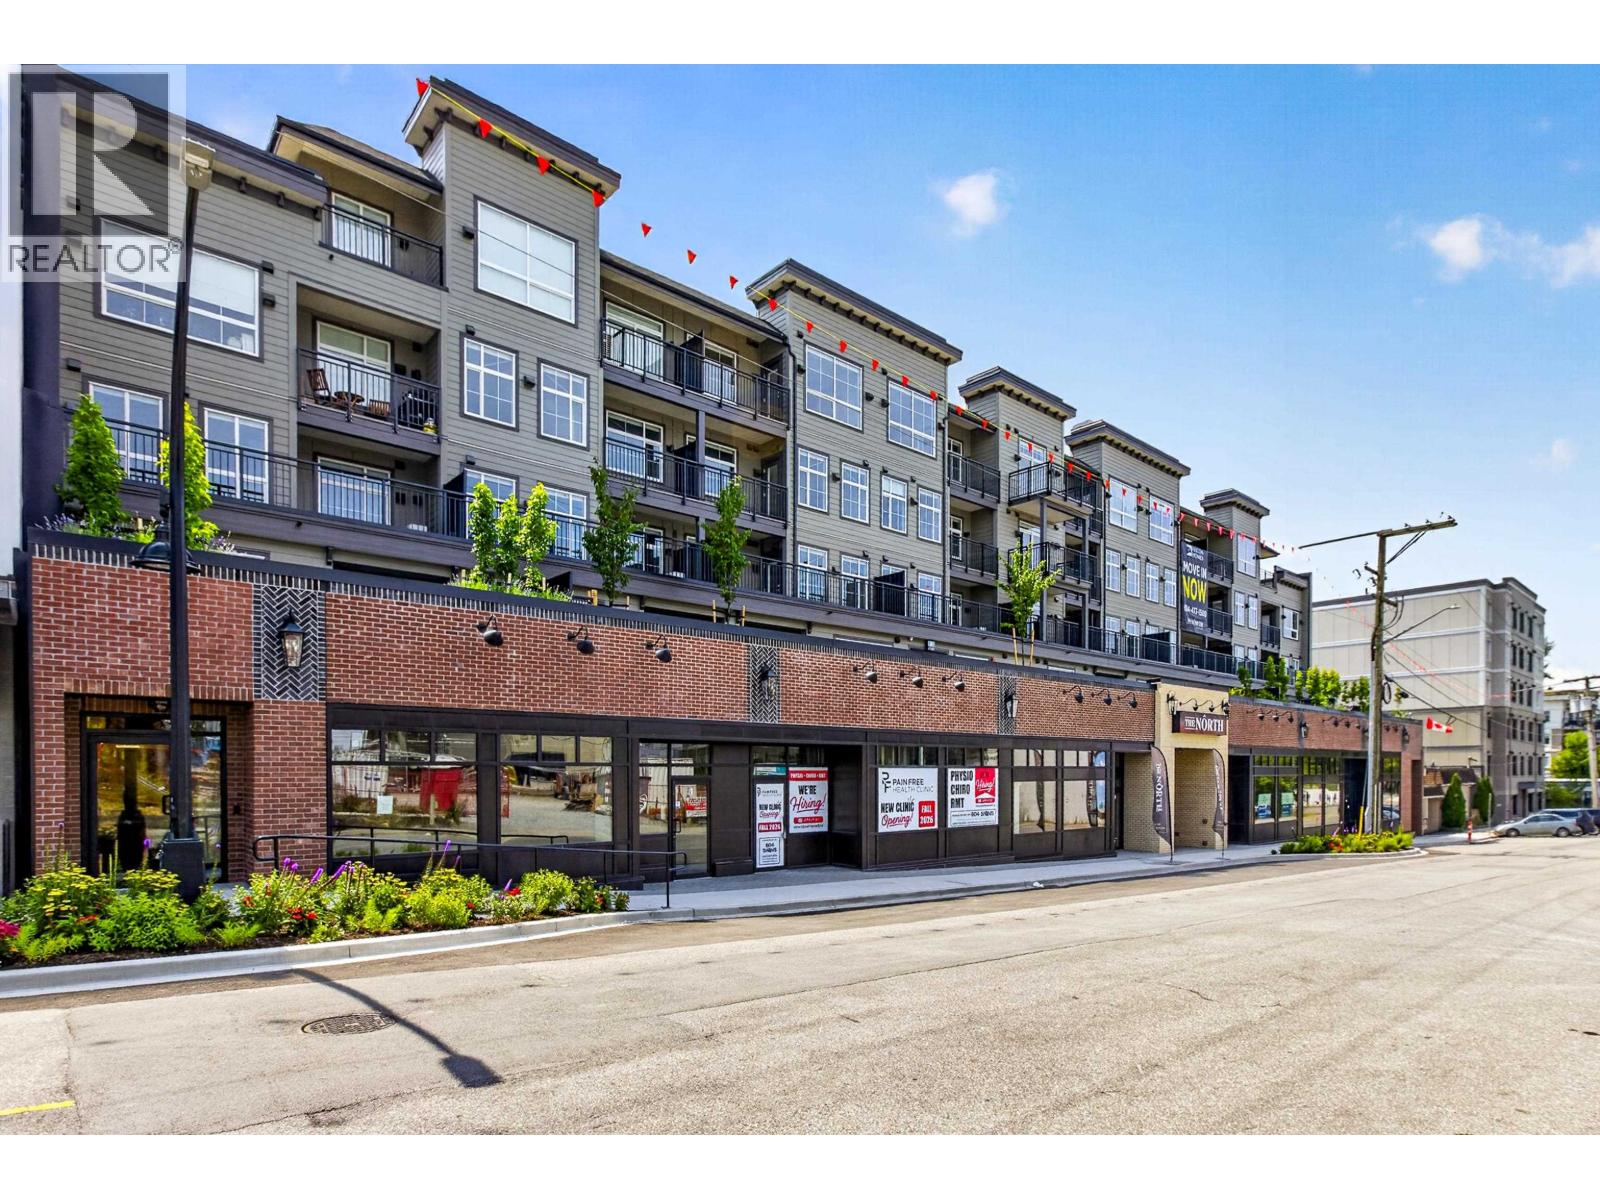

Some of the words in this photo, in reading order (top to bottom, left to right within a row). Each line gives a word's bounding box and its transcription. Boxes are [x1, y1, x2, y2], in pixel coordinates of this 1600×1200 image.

[1183, 561, 1200, 576] MOVE
[1201, 566, 1207, 579] IN
[1183, 575, 1207, 604] NOW
[1184, 718, 1196, 728] THE
[950, 770, 974, 782] PHYSIO
[798, 785, 816, 795] WE'RE
[892, 785, 915, 793] HEALTH
[916, 785, 934, 793] CLINIC
[950, 784, 971, 795] CHIRO
[790, 793, 827, 815] Hiring!
[880, 802, 895, 813] NEW
[895, 801, 915, 813] CLINIC
[921, 804, 933, 813] FALL
[950, 797, 965, 809] RMT
[881, 812, 914, 828] Opening!
